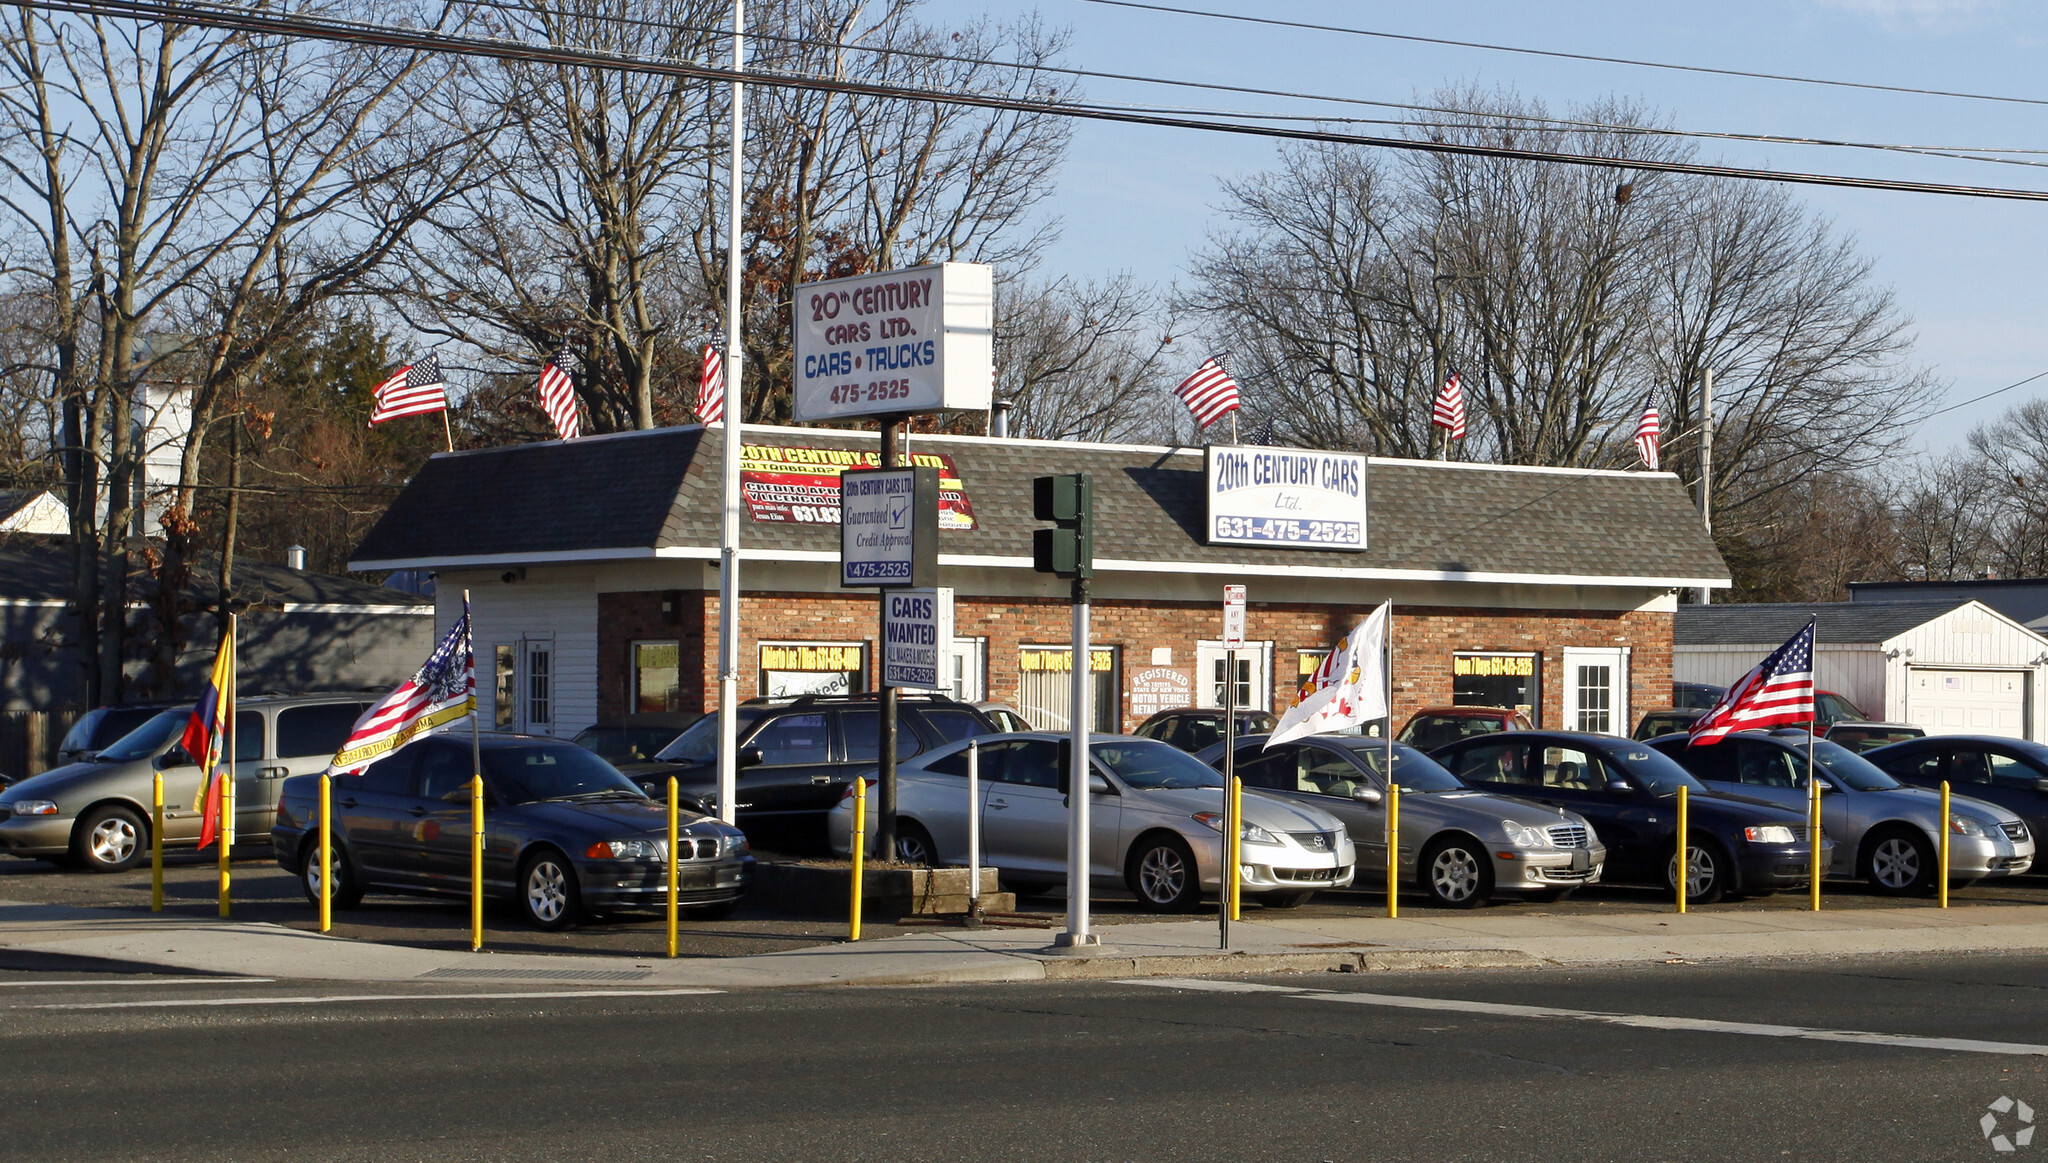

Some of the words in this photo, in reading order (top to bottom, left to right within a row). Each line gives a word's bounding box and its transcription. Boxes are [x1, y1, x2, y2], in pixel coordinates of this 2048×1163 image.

[852, 278, 932, 315] CENTURY
[825, 322, 871, 345] CARS
[880, 317, 917, 339] LTD.
[805, 351, 852, 378] CARS
[866, 340, 935, 372] TRUCKS
[830, 379, 910, 404] 475-2525
[740, 445, 783, 462] 20TH
[784, 446, 863, 467] CENTURY
[864, 451, 913, 467] CS
[912, 454, 949, 470] LTD.
[1217, 452, 1248, 492] 20th
[1254, 453, 1318, 485] CENTURY
[1322, 457, 1359, 497] CARS
[745, 482, 806, 494] CREDITO
[846, 479, 859, 496] 20th
[860, 478, 884, 495] CENTURY
[885, 478, 900, 494] CARS
[748, 491, 758, 501] Y
[759, 493, 826, 505] LICENCIA
[1274, 492, 1303, 511] Ltd.
[791, 505, 841, 524] 631.83
[846, 504, 889, 526] Guaranteed
[856, 532, 879, 548] Credit
[879, 530, 913, 551] Approval
[1217, 516, 1360, 544] 631-475-2525
[853, 562, 909, 577] 475-2525
[892, 597, 932, 619] CARS
[888, 622, 935, 645] WANTED
[761, 646, 785, 669] Abierto
[888, 647, 896, 662] ALL
[897, 647, 912, 664] MAKES
[917, 648, 935, 666] MODELS
[1021, 650, 1040, 671] Open
[1040, 651, 1045, 670] 7
[1046, 651, 1063, 672] Days
[1454, 656, 1470, 677] Open
[1471, 657, 1475, 675] 7
[1475, 657, 1491, 677] Days
[1491, 656, 1533, 676] 631-475-2525
[888, 666, 935, 683] 631-475-2525
[1133, 668, 1188, 687] REGISTERED
[1132, 694, 1158, 703] MOTOR
[1160, 694, 1190, 703] VEHICLE
[1133, 704, 1158, 714] RETAIL
